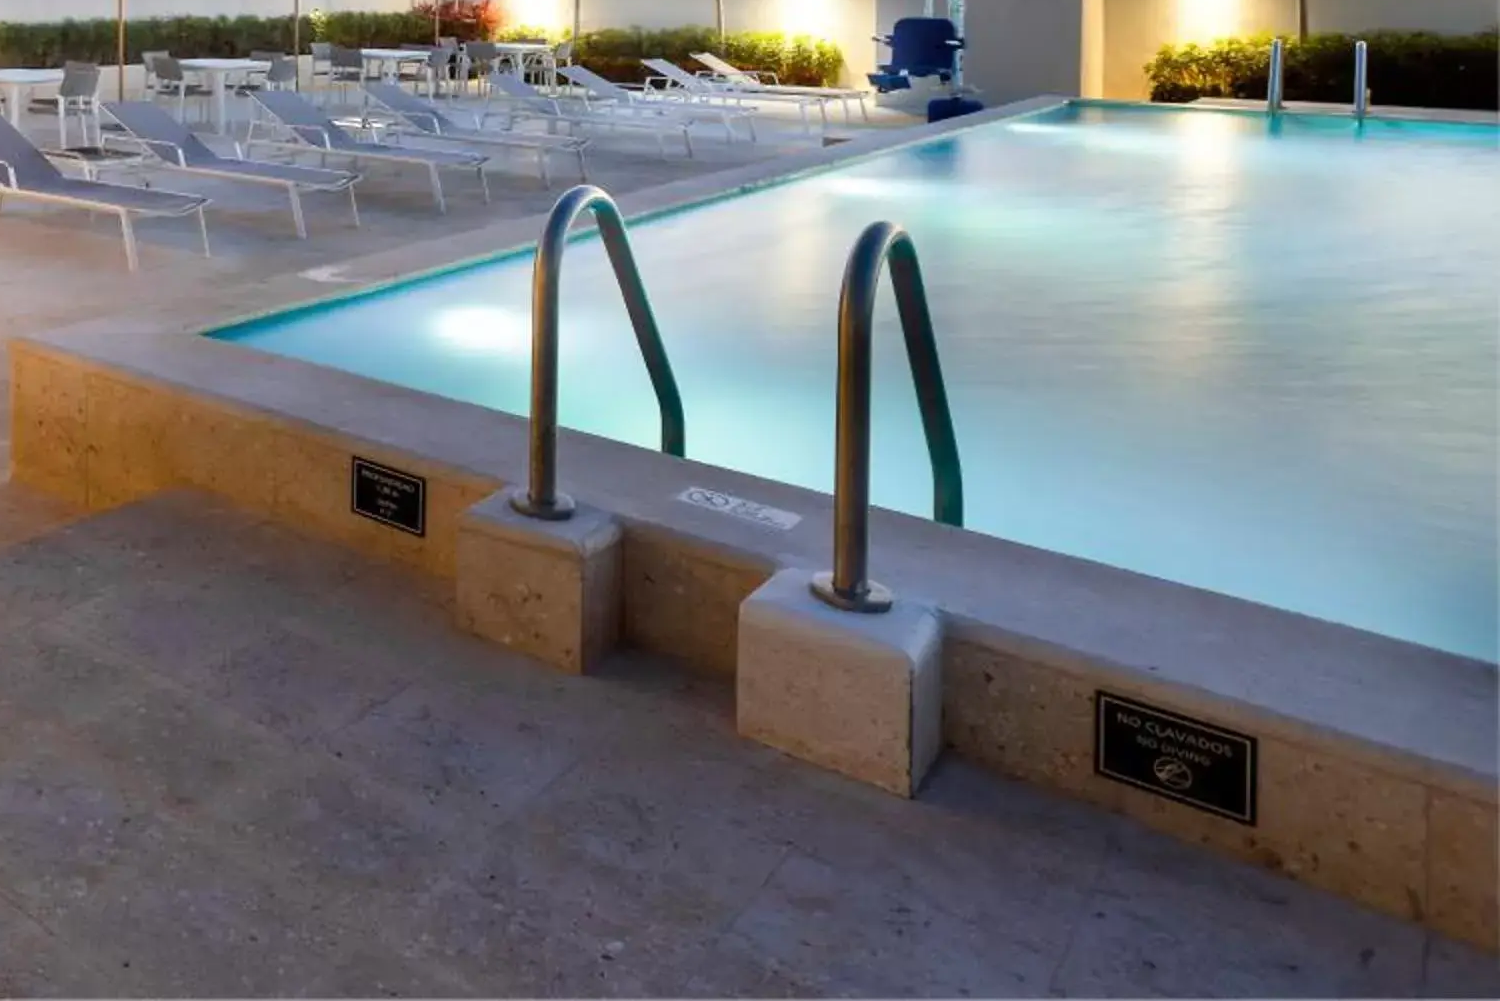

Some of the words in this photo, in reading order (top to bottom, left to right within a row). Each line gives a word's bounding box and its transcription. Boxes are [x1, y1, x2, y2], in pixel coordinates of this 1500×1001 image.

[1116, 712, 1141, 728] NO
[1145, 721, 1233, 758] CLAVADOS
[1136, 734, 1157, 749] NO
[1160, 744, 1212, 767] DIVING
